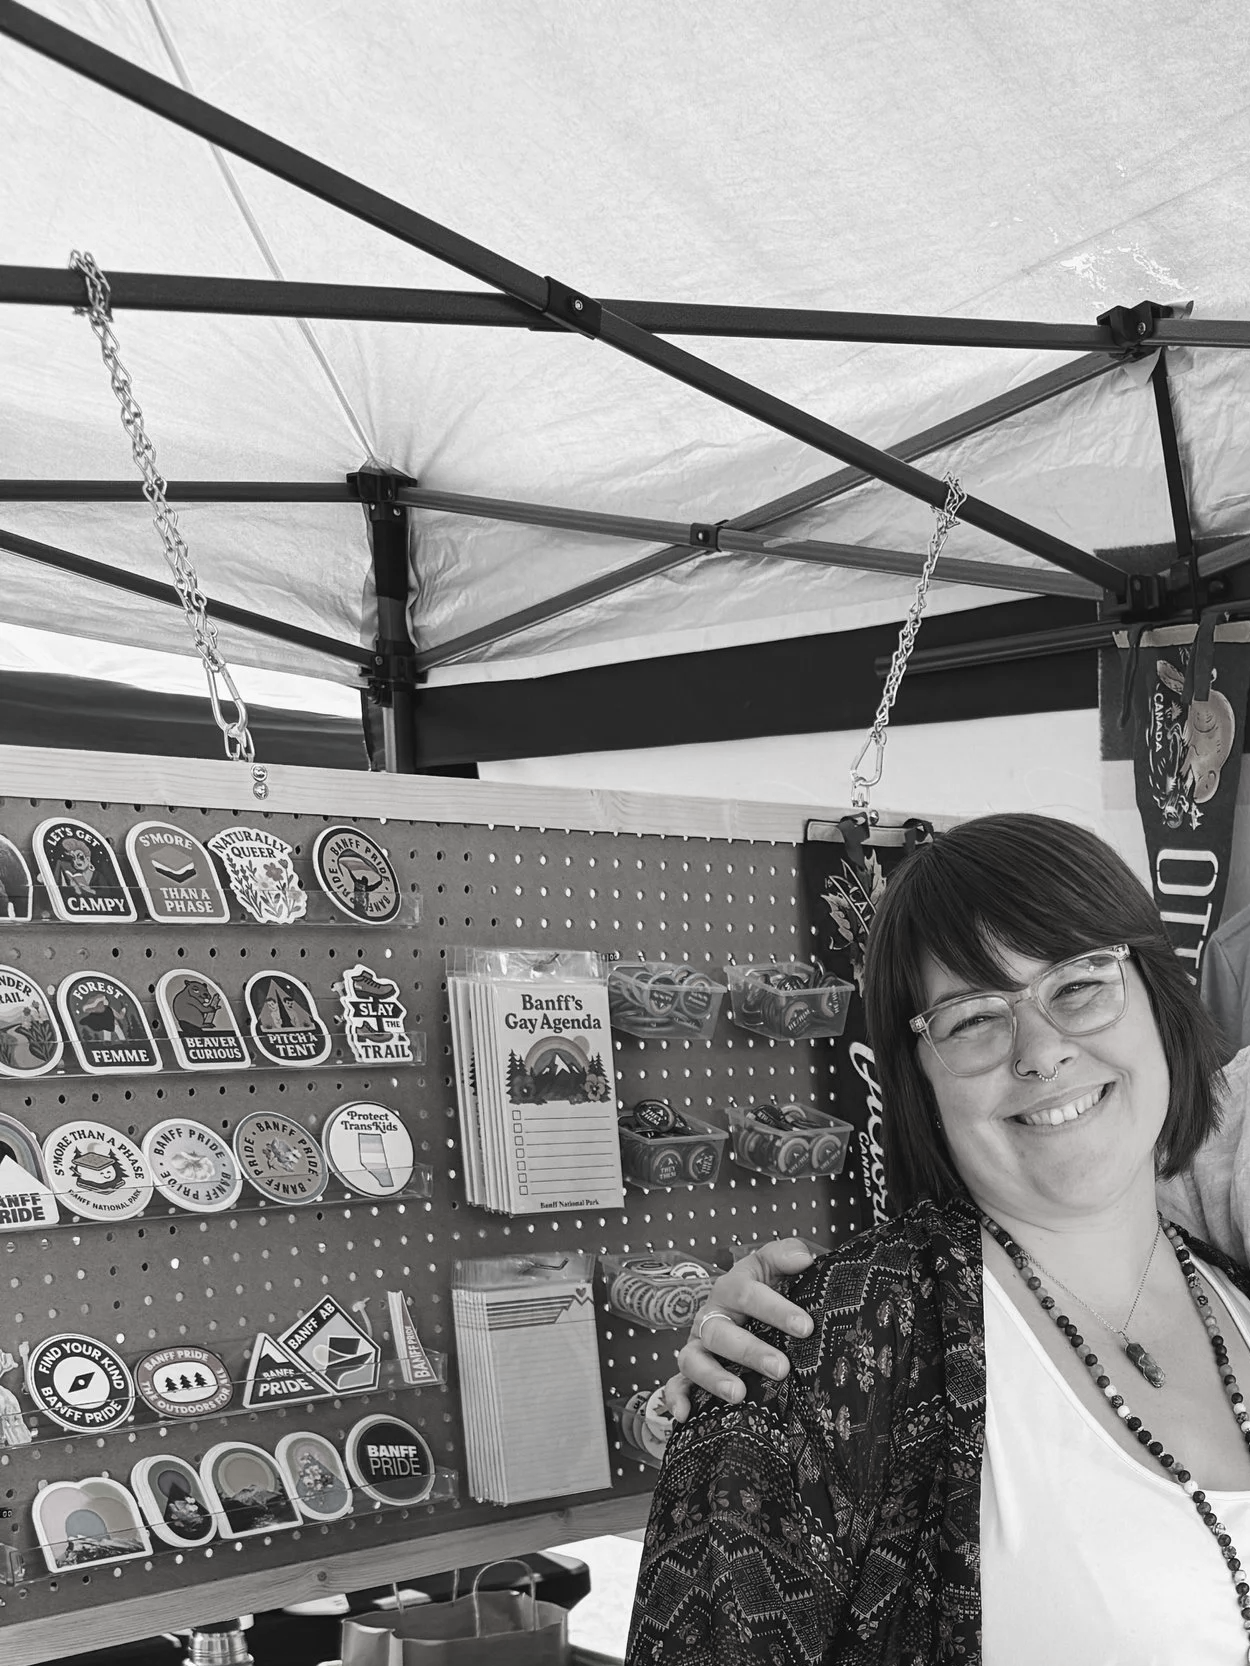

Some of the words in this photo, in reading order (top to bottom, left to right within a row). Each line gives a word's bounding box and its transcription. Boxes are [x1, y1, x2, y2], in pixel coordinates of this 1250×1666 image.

[1153, 693, 1163, 753] CANADA
[47, 827, 73, 846] LET'S
[76, 830, 100, 847] GET
[139, 833, 193, 850] S'MORE
[212, 830, 288, 853] NATURALLY
[232, 845, 277, 859] QUEER
[330, 838, 360, 856] BANFF
[365, 846, 390, 882] PRIDE
[160, 888, 200, 900] THAN
[201, 888, 210, 900] A
[67, 897, 125, 912] CAMPY
[166, 901, 214, 913] PHASE
[367, 895, 391, 912] BANF
[1156, 848, 1219, 985] OTT
[73, 982, 124, 1000] FOREST
[359, 1003, 394, 1016] SLAY
[521, 994, 583, 1011] Banff's
[385, 1020, 401, 1029] THE
[504, 1012, 538, 1034] Gay
[540, 1012, 602, 1034] Agenda
[186, 1036, 237, 1048] BEAVER
[269, 1032, 307, 1045] PITCH
[308, 1032, 318, 1042] A
[92, 1049, 149, 1063] FEMME
[189, 1048, 242, 1060] CURIOUS
[275, 1043, 317, 1058] TENT
[360, 1044, 410, 1059] TRAIL
[347, 1111, 390, 1121] Protect
[341, 1121, 373, 1131] Trans
[372, 1121, 398, 1134] Kids
[154, 1128, 183, 1156] BANFF
[188, 1129, 226, 1159] PRIDE
[256, 1121, 297, 1137] BANFF
[297, 1138, 320, 1177] PRIDE
[53, 1134, 73, 1177] S'MORE
[69, 1129, 105, 1142] THAN
[106, 1137, 116, 1147] A
[117, 1143, 145, 1180] PHASE
[243, 1136, 264, 1177] PRIDE
[858, 1131, 872, 1198] CANADA
[160, 1170, 200, 1201] PRIDE
[206, 1171, 232, 1201] BANFF
[266, 1178, 307, 1195] BANFF
[92, 1202, 130, 1211] NATIONAL
[128, 1189, 142, 1204] PARK
[559, 1199, 585, 1207] National
[585, 1198, 600, 1206] Park
[288, 1317, 319, 1350] BANFF
[319, 1302, 336, 1321] AB
[38, 1347, 62, 1374] FIND
[61, 1342, 102, 1360] YOUR
[101, 1357, 125, 1390] KIND
[144, 1351, 175, 1371] BANFF
[177, 1350, 209, 1362] PRIDE
[408, 1345, 431, 1378] BANFF
[258, 1379, 314, 1397] PRIDE
[41, 1387, 83, 1421] BANFF
[84, 1400, 122, 1424] PRIDE
[142, 1381, 159, 1401] THE
[157, 1400, 217, 1414] OUTDOORS
[214, 1388, 231, 1405] FOR
[367, 1445, 417, 1457] BANFF
[369, 1457, 422, 1476] PRIDE
